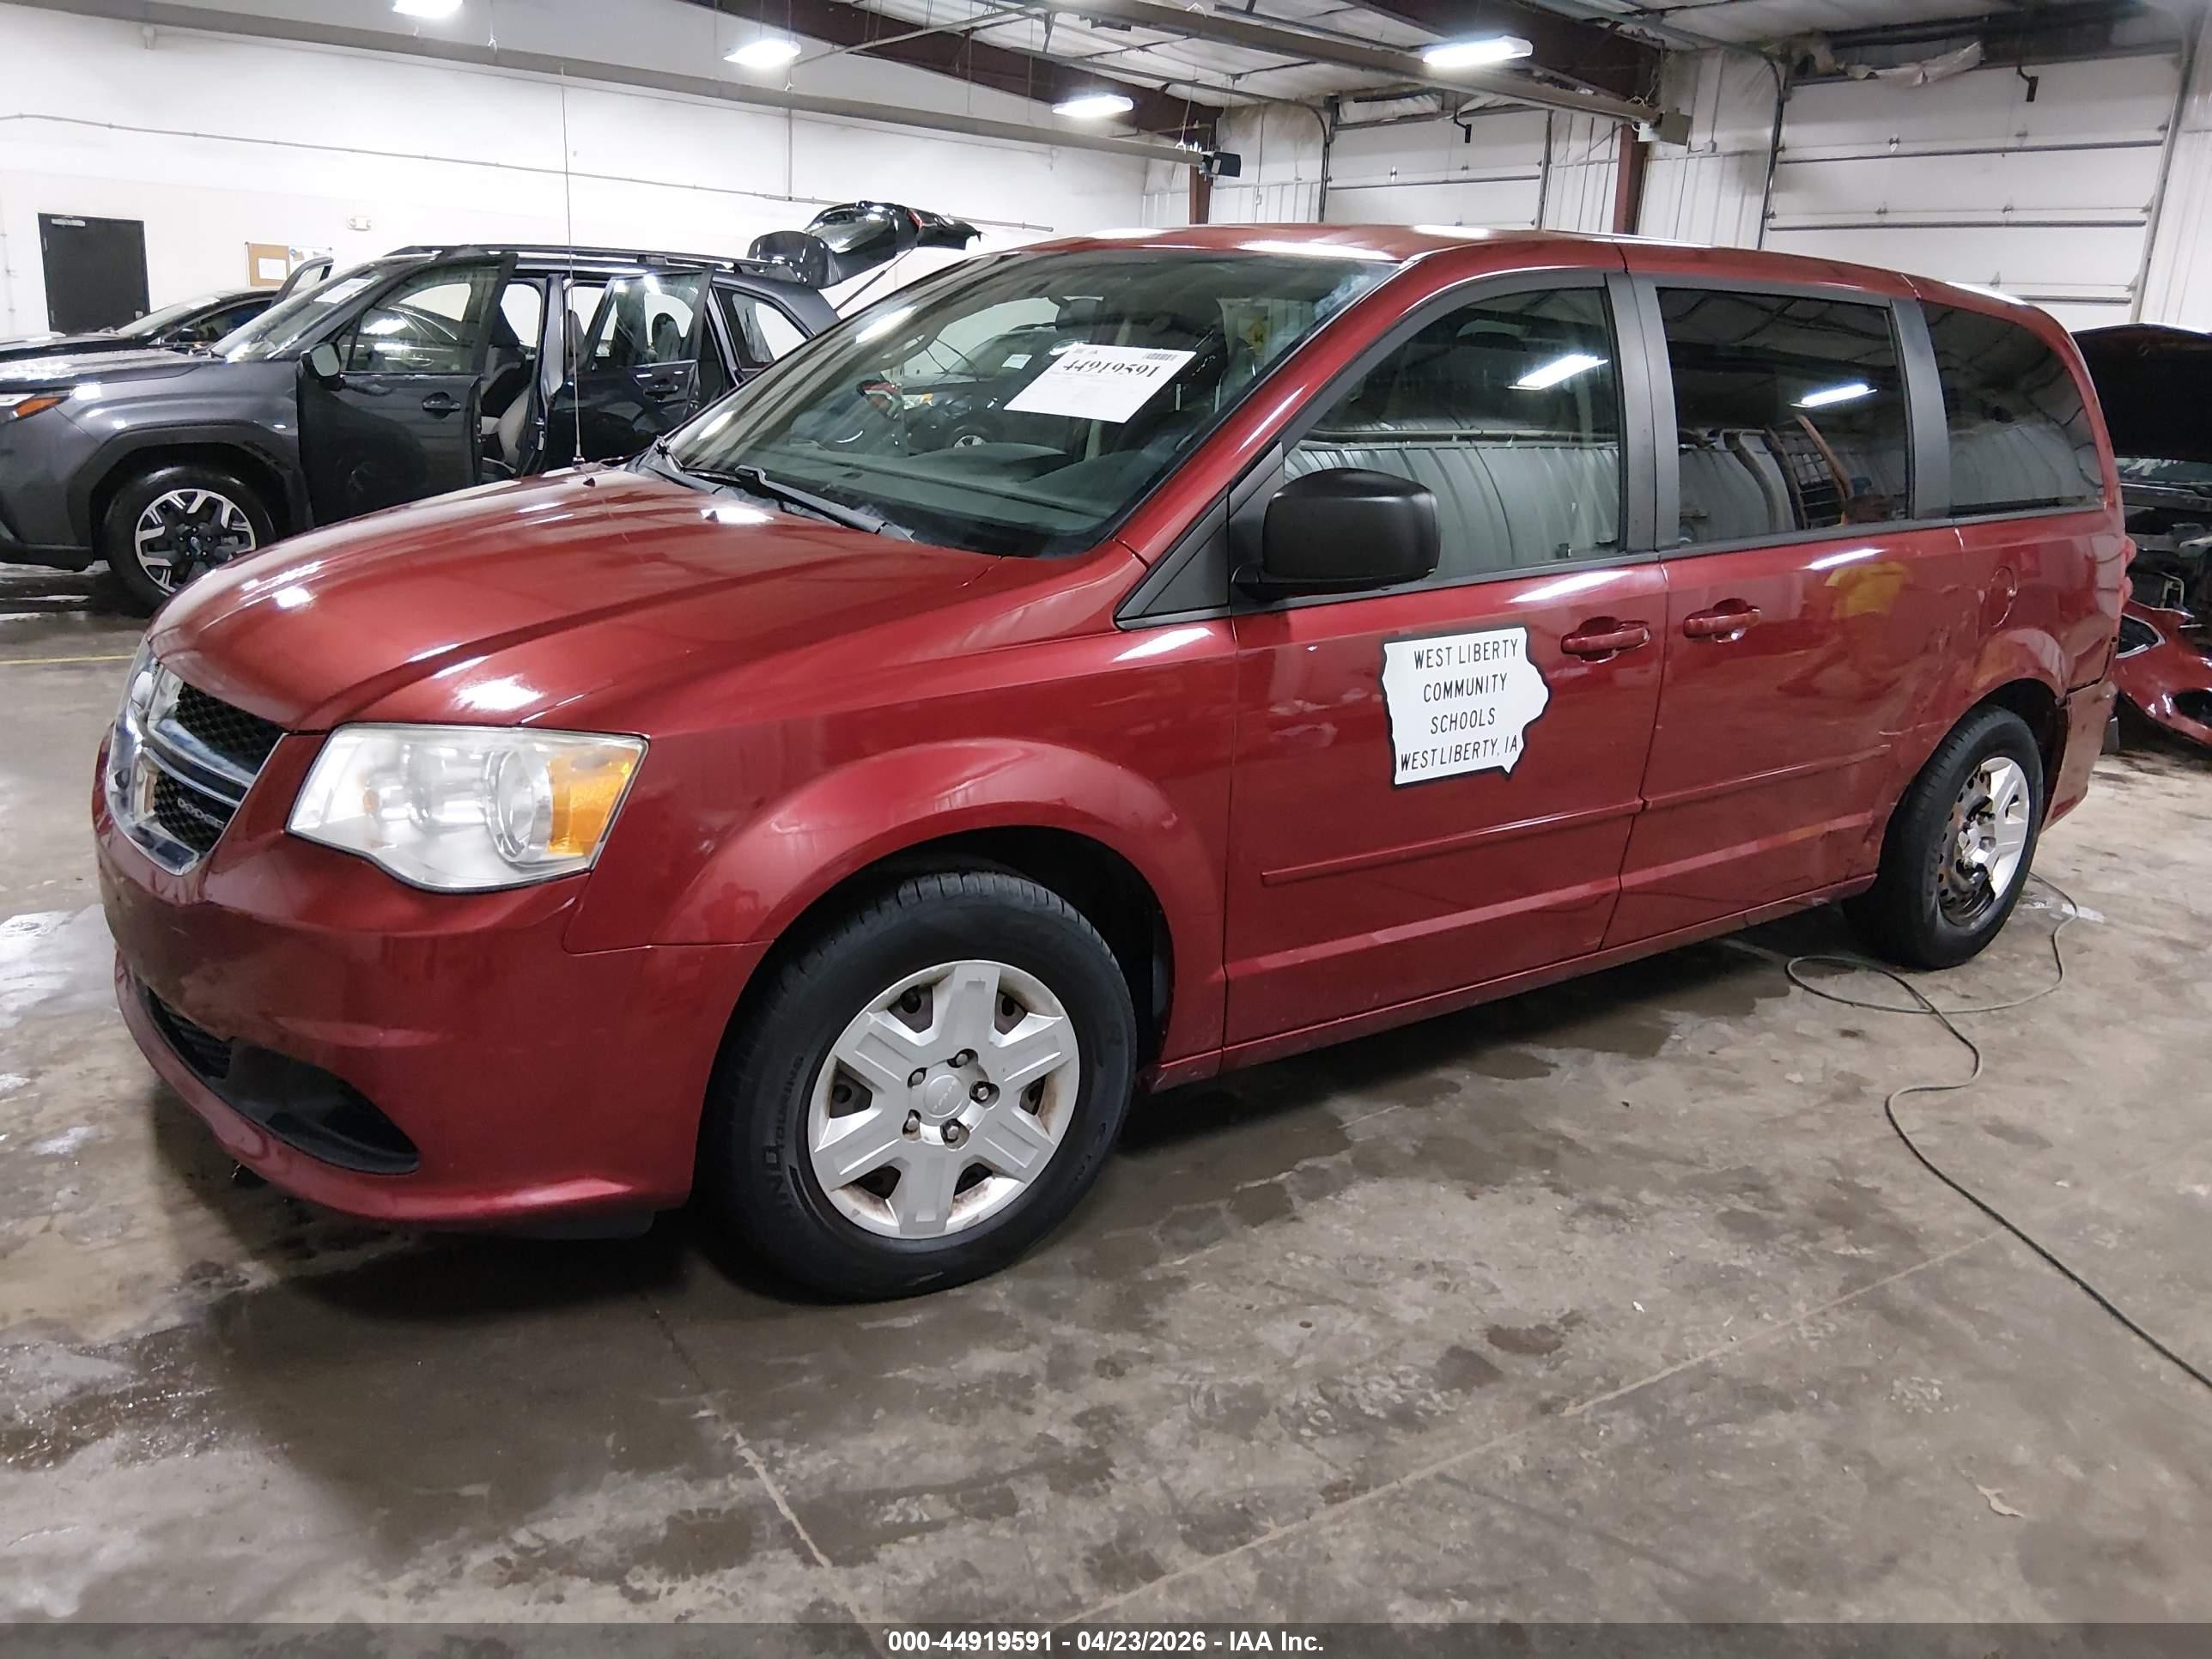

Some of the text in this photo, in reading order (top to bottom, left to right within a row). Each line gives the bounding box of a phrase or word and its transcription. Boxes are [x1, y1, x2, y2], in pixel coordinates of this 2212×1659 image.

[1063, 359, 1161, 378] 44919591
[1413, 638, 1518, 670] WEST LIBERTY
[1423, 672, 1508, 702] COMMUNITY
[1430, 707, 1496, 735] SCHOOLS
[1401, 748, 1438, 772] WEST
[1504, 734, 1518, 753] IA
